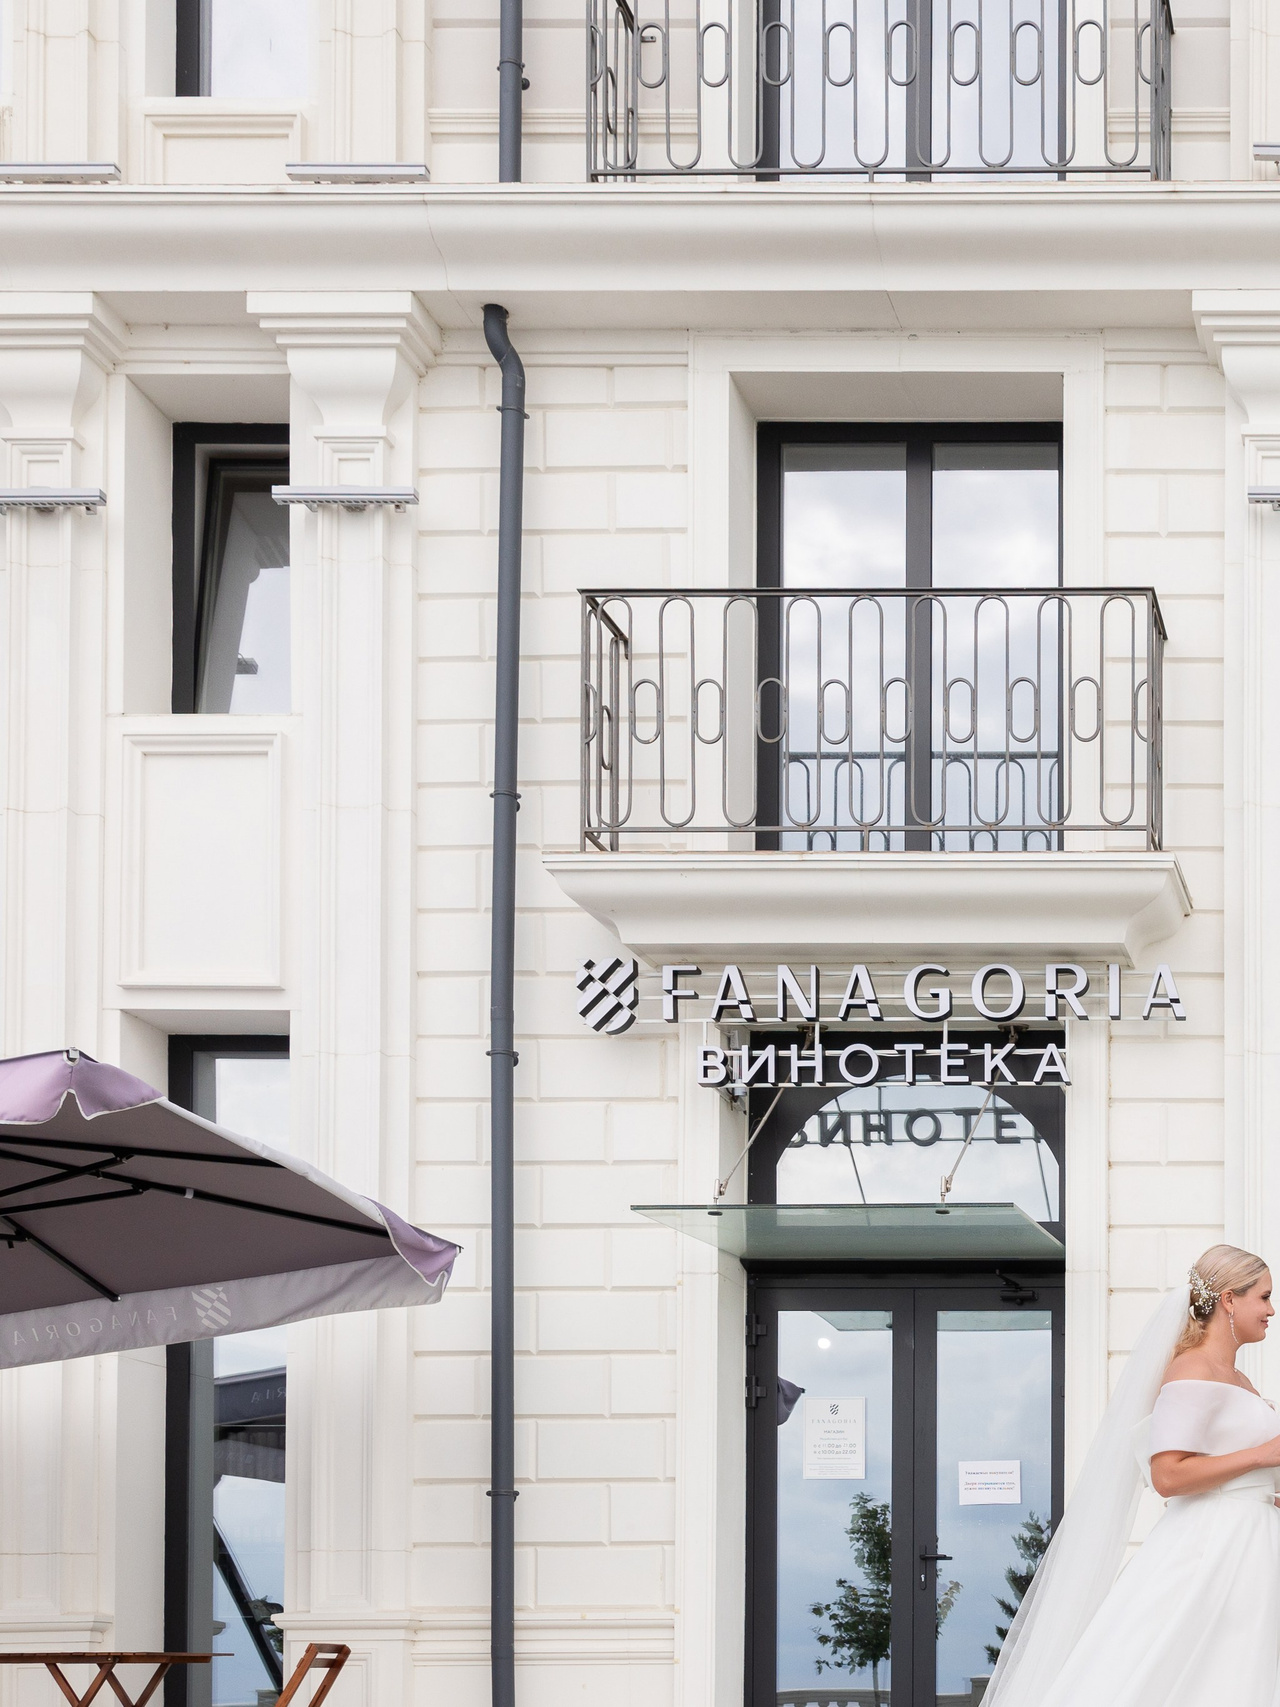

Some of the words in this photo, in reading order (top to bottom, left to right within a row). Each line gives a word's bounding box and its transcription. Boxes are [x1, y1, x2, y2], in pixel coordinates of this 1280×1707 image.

[662, 963, 1187, 1022] FANAGORIA
[697, 1043, 1072, 1087] ВИНОТЕКА
[786, 1107, 1045, 1148] ИНОТЕ
